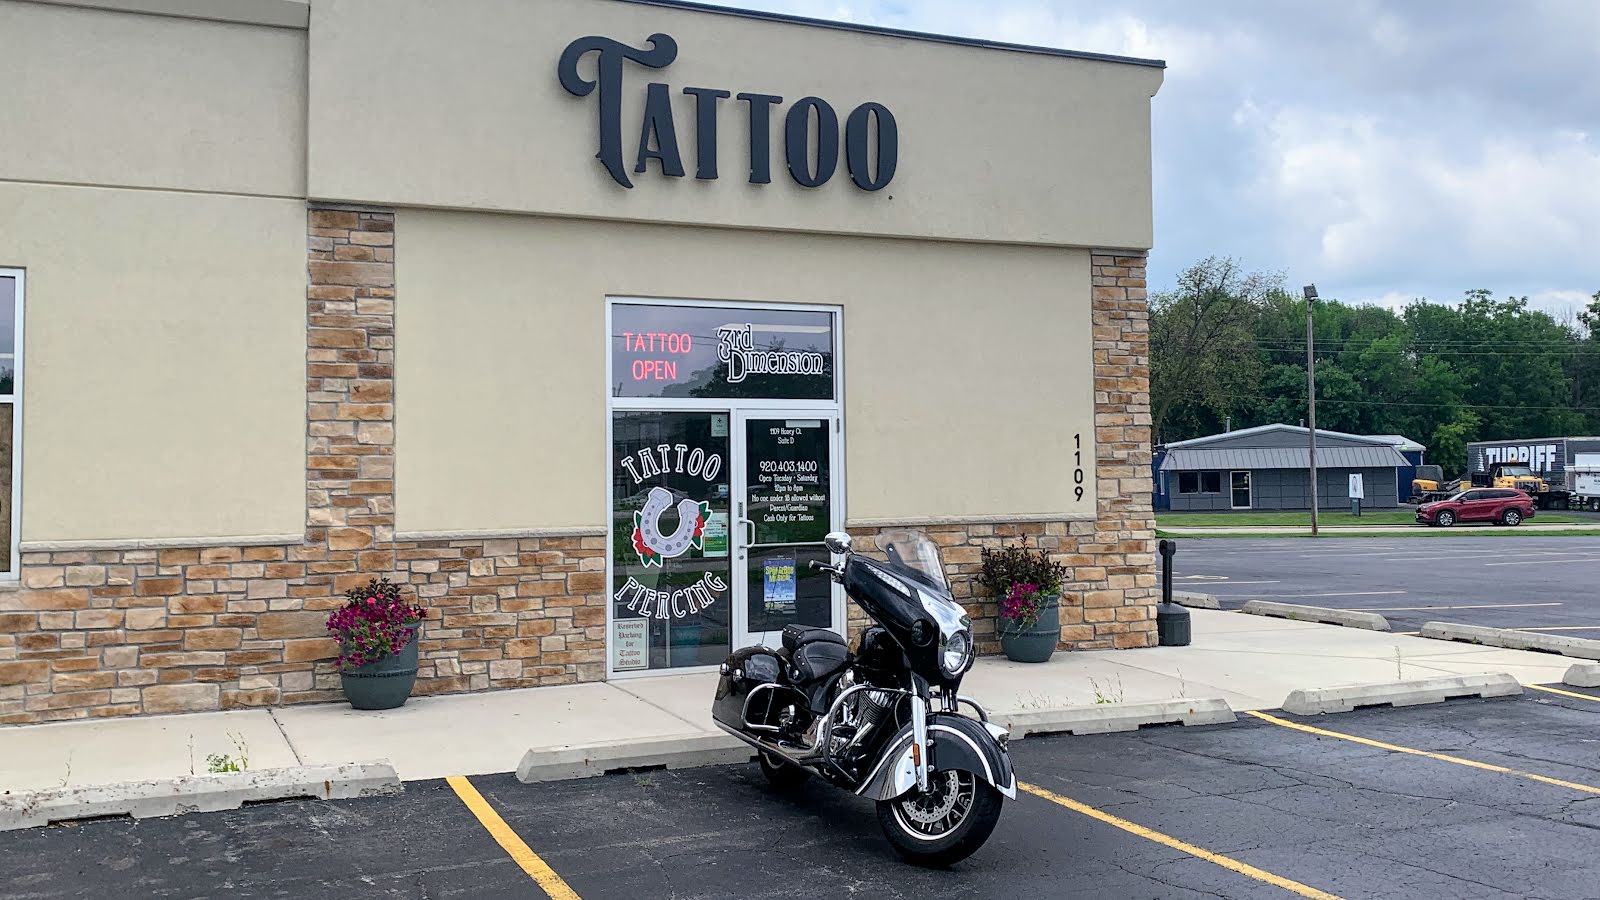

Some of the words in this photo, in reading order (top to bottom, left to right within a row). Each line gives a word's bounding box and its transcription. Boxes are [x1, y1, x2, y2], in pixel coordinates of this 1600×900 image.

[557, 33, 898, 191] TATTOO
[623, 332, 692, 353] TATTOO
[717, 323, 754, 362] 3rd
[632, 360, 676, 380] OPEN
[727, 349, 824, 383] Dimension
[621, 444, 721, 484] TATTOO
[759, 460, 818, 473] 920.403.1400
[1073, 433, 1084, 502] 1109
[759, 474, 772, 483] Open
[773, 473, 793, 483] Tuesday
[796, 473, 818, 483] Saturday
[787, 484, 793, 492] to
[751, 493, 760, 502] No
[769, 493, 784, 502] under
[791, 493, 809, 502] allowed
[809, 493, 826, 502] without
[763, 513, 776, 522] Cash
[776, 513, 788, 523] Only
[788, 513, 797, 522] for
[797, 513, 815, 522] Tattoos
[614, 571, 728, 620] PIERCING
